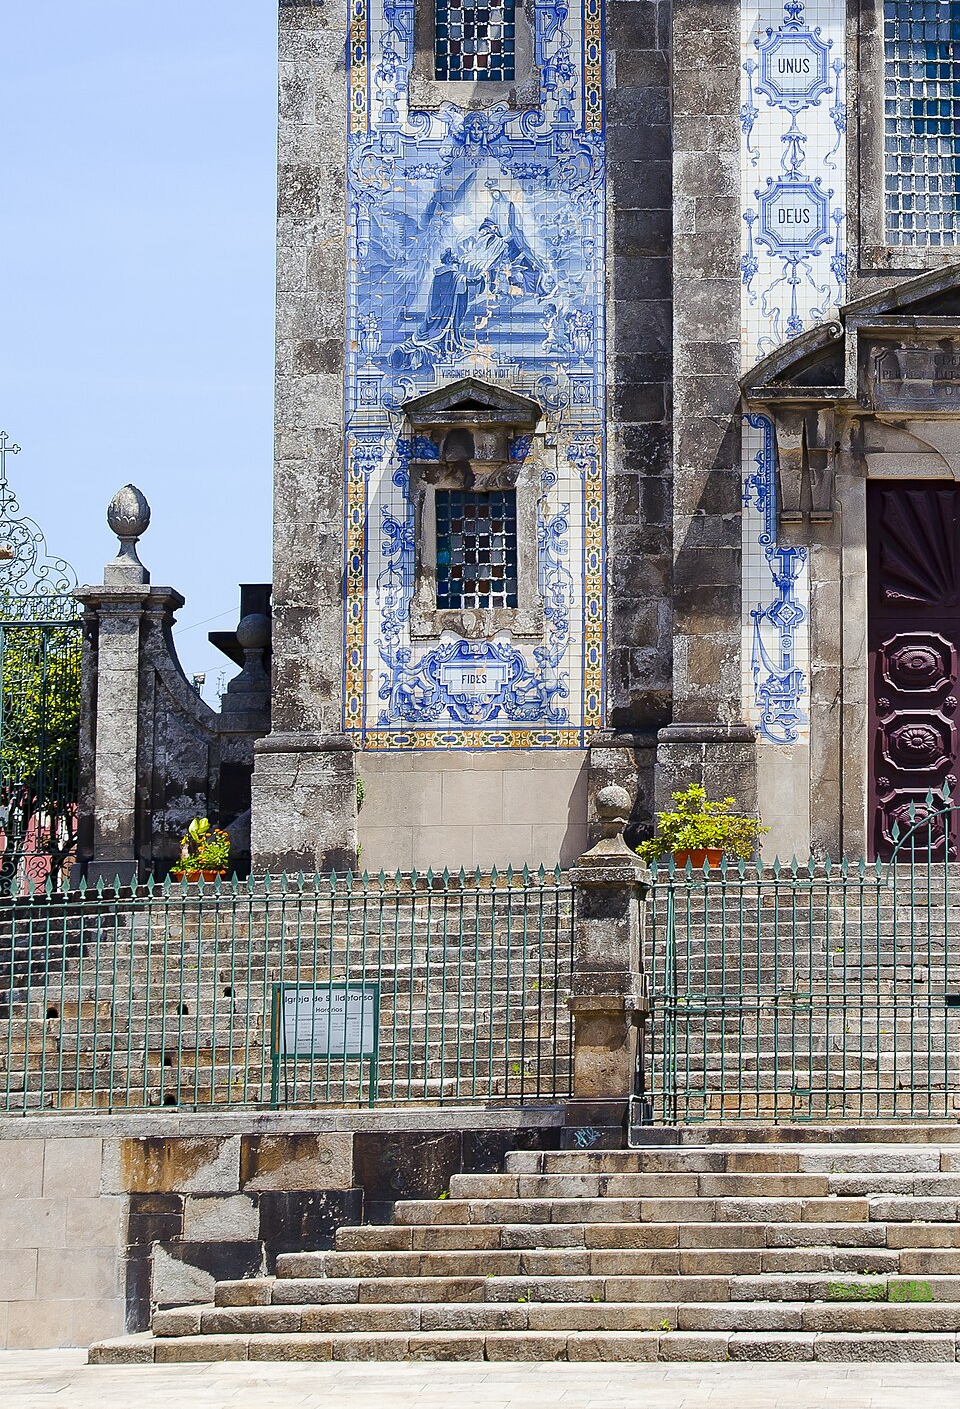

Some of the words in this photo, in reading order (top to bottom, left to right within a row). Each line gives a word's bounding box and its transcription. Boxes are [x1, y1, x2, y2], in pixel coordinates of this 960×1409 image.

[778, 58, 810, 74] UNUS
[778, 208, 810, 224] DEUS
[461, 674, 487, 684] FIDES
